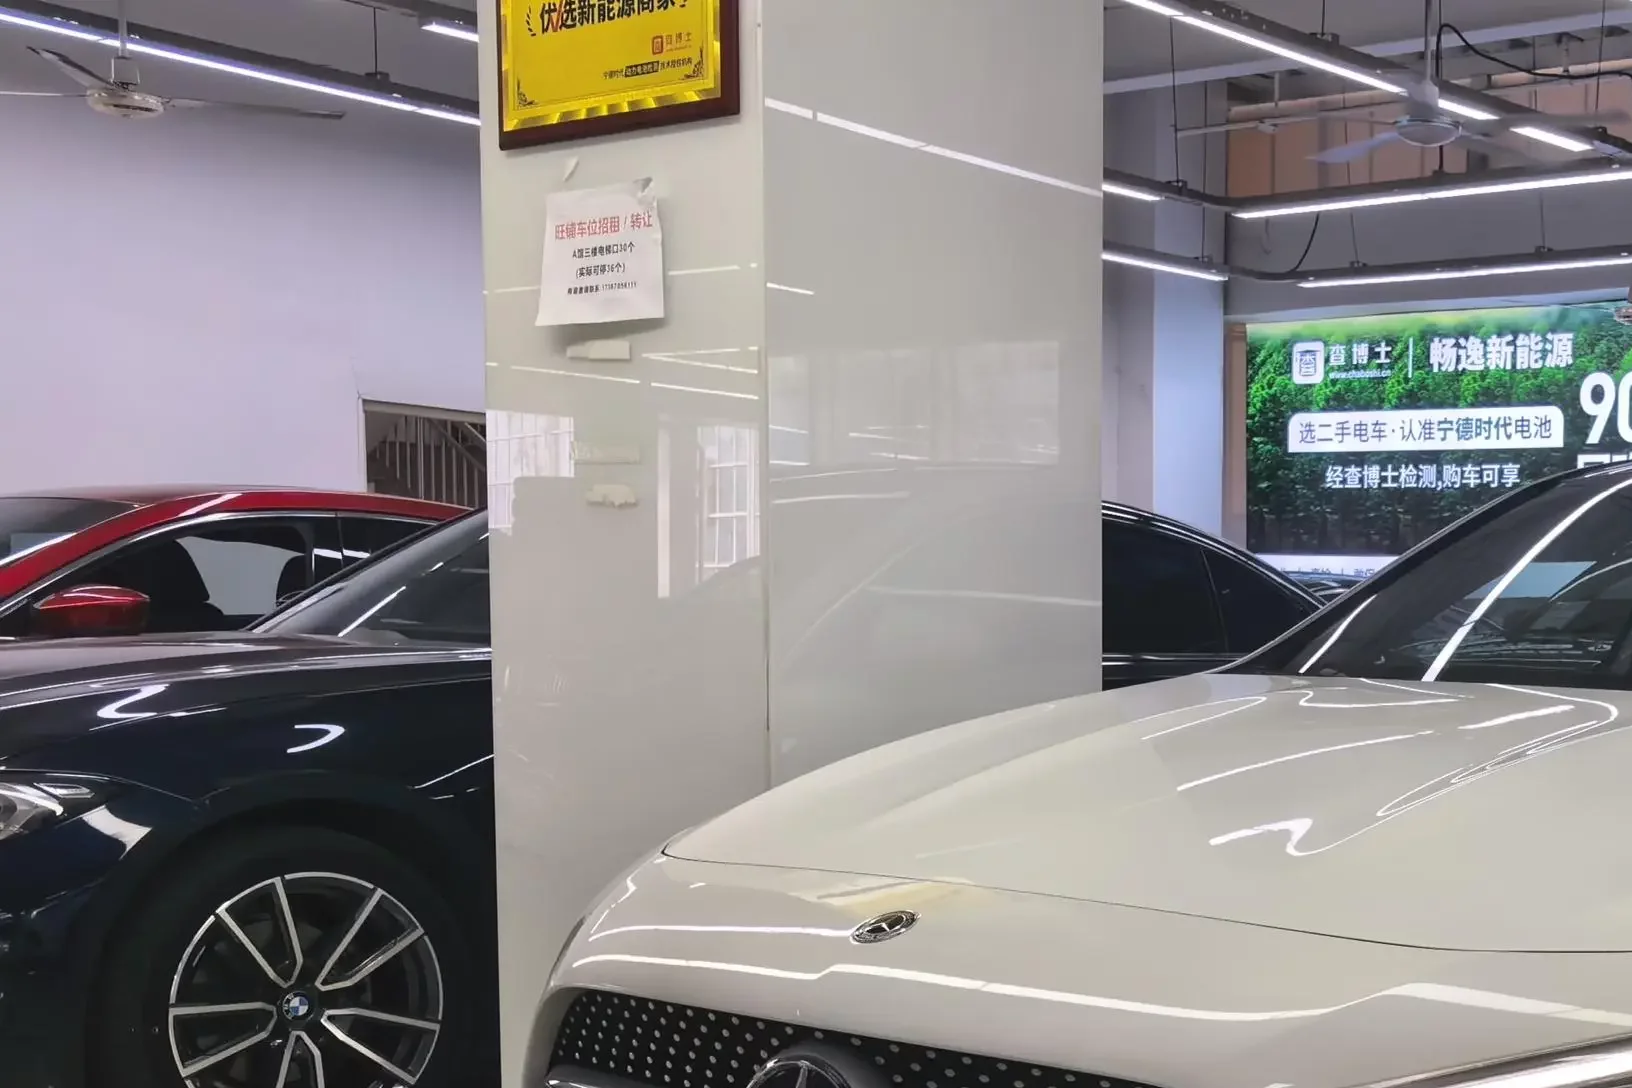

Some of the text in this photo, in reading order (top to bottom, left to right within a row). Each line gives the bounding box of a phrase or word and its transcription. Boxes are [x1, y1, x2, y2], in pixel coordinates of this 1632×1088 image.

[630, 210, 653, 230] 转让
[1329, 332, 1574, 373] 查博士 畅逸新能源
